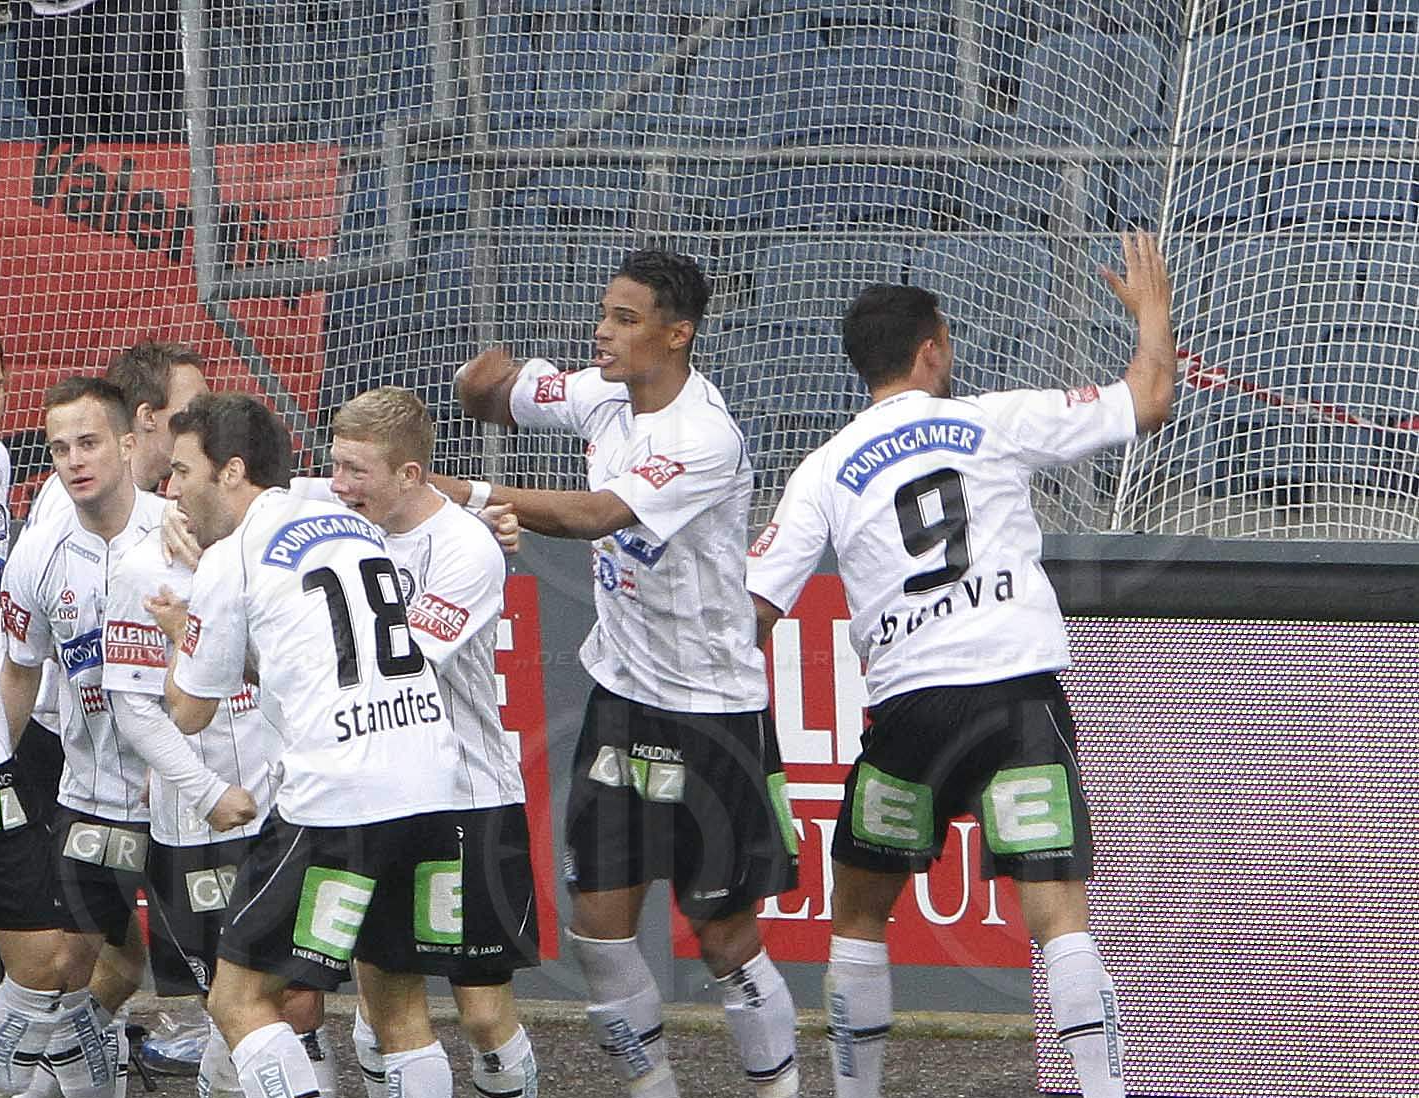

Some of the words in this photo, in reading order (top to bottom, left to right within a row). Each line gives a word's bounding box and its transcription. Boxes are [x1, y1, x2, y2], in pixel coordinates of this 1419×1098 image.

[842, 421, 977, 488] PUNTIGAMER
[894, 467, 973, 595] 9
[302, 556, 427, 692] 18
